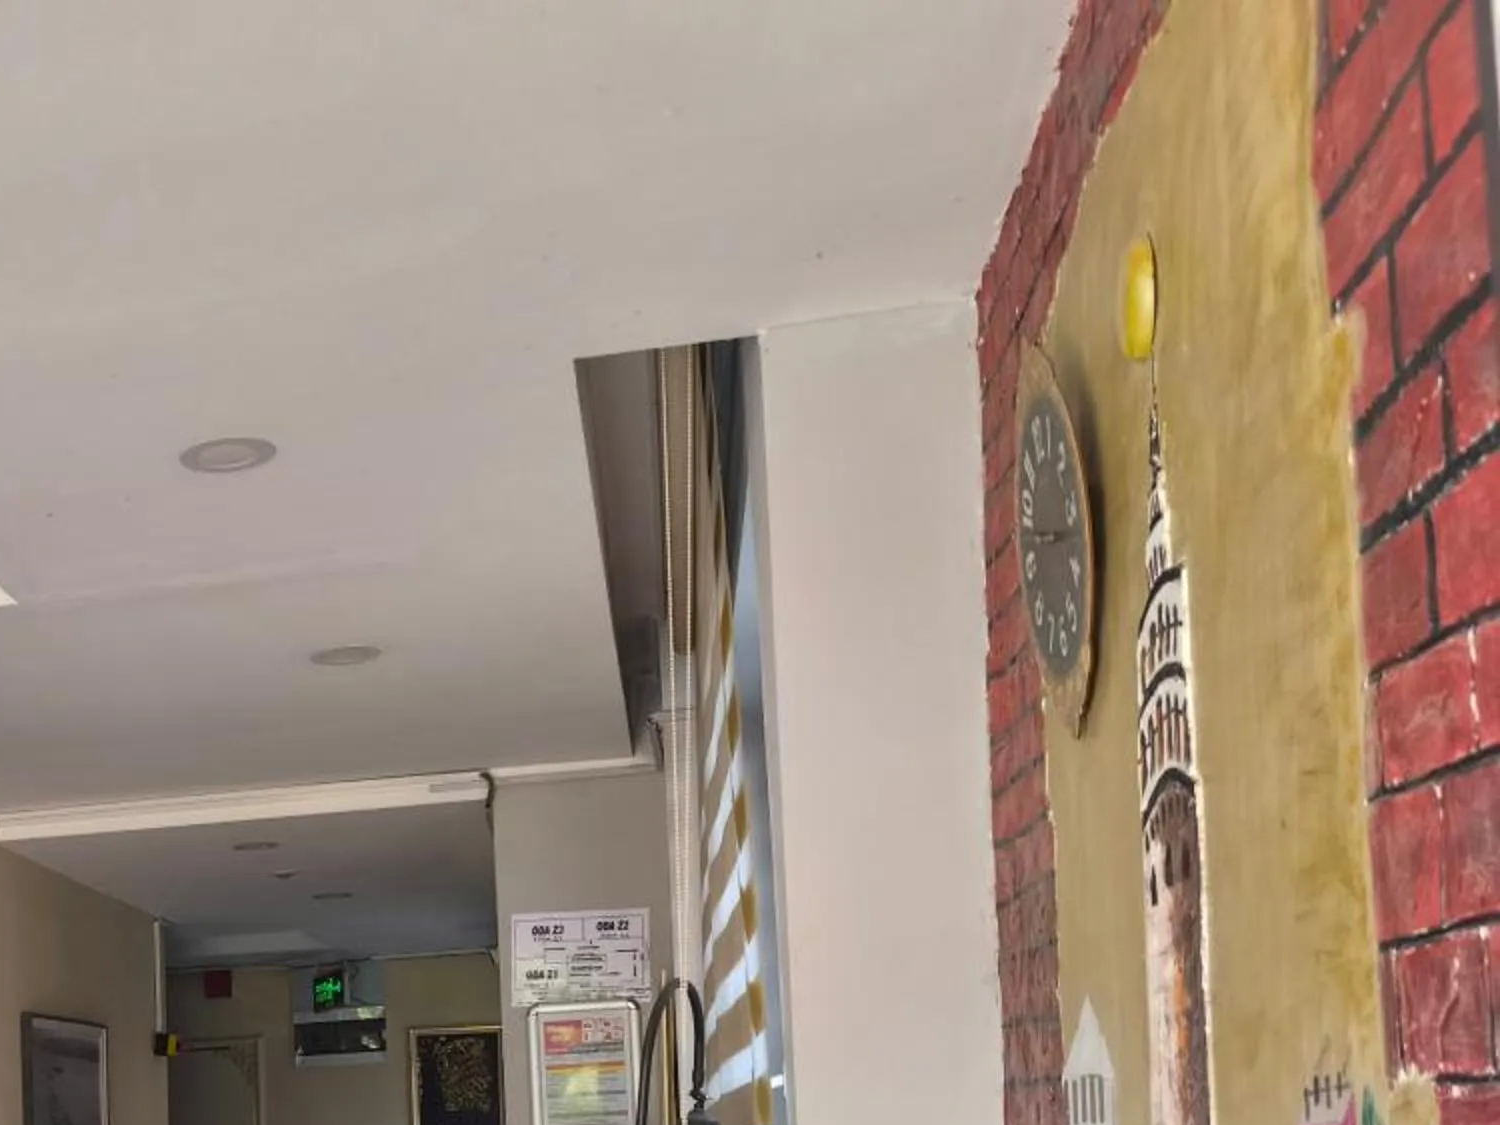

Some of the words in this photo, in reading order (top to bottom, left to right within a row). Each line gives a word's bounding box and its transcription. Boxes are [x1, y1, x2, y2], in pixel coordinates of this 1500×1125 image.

[1056, 441, 1068, 497] 2
[1021, 488, 1033, 529] 10
[1065, 491, 1077, 528] 3
[1065, 591, 1077, 632] 5
[1047, 612, 1055, 654] 7
